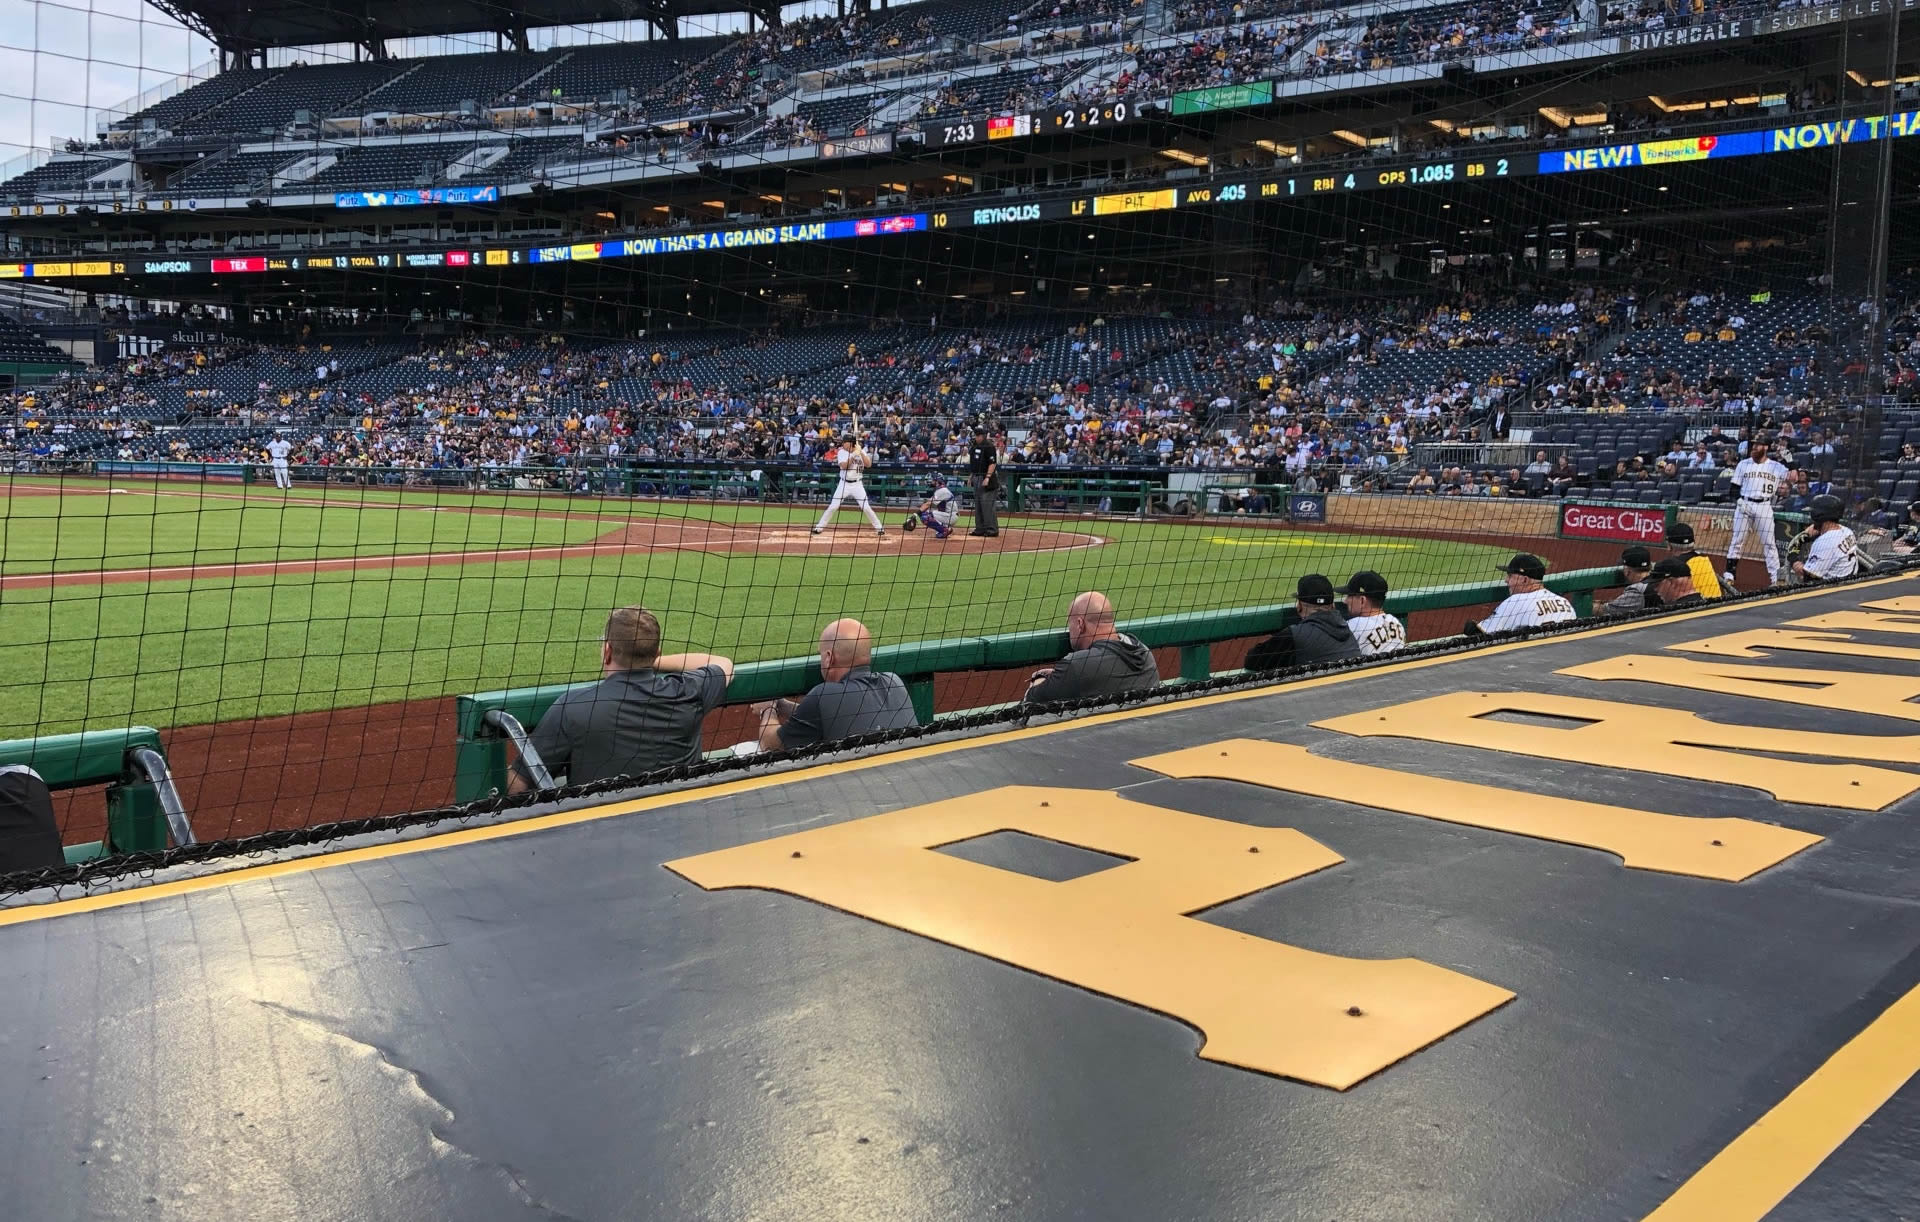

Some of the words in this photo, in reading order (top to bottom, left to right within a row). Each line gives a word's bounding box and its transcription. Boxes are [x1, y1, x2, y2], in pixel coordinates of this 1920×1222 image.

[1772, 7, 1840, 29] SUITE
[1630, 21, 1740, 51] RIVENDALE
[995, 119, 1009, 127] TEX
[1034, 118, 1041, 128] 2
[1064, 110, 1075, 128] 2
[1088, 107, 1099, 126] 2
[1115, 103, 1126, 121] 0
[944, 124, 975, 144] 7:33
[996, 128, 1007, 136] PIT
[1774, 118, 1856, 152] NOW
[1564, 145, 1634, 172] NEW!
[1187, 189, 1211, 203] AVG
[1215, 184, 1247, 202] .405
[1261, 183, 1278, 197] HR
[1288, 180, 1296, 195] 1
[1313, 177, 1335, 192] RBI
[1344, 173, 1356, 189] 4
[1378, 170, 1406, 185] OPS
[1410, 163, 1455, 184] 1.085
[1466, 163, 1485, 177] BB
[1496, 158, 1508, 175] 2
[1124, 195, 1145, 209] PIT
[933, 213, 948, 228] 10
[973, 204, 1041, 225] REYNOLDS
[1071, 201, 1087, 215] LF
[623, 239, 656, 256] NOW
[661, 232, 706, 251] THAT'S
[709, 232, 720, 248] A
[724, 227, 777, 248] GRAND
[779, 222, 827, 243] SLAM!
[450, 254, 465, 264] TEX
[472, 252, 480, 265] 5
[491, 252, 504, 263] PIT
[512, 251, 520, 263] 5
[539, 246, 569, 262] NEW!
[114, 263, 125, 274] 52
[144, 262, 191, 274] SAMPSON
[230, 259, 248, 271] TEX
[269, 259, 288, 269] BALL
[292, 257, 299, 269] 6
[307, 258, 334, 268] STRIKE
[336, 256, 348, 268] 13
[351, 257, 375, 267] TOTAL
[377, 255, 390, 267] 19
[42, 265, 62, 275] 7:33
[172, 330, 206, 343] skull
[1762, 483, 1774, 494] 19
[1564, 507, 1615, 530] Great
[1617, 510, 1663, 539] Clips
[1535, 599, 1572, 616] JAUSS
